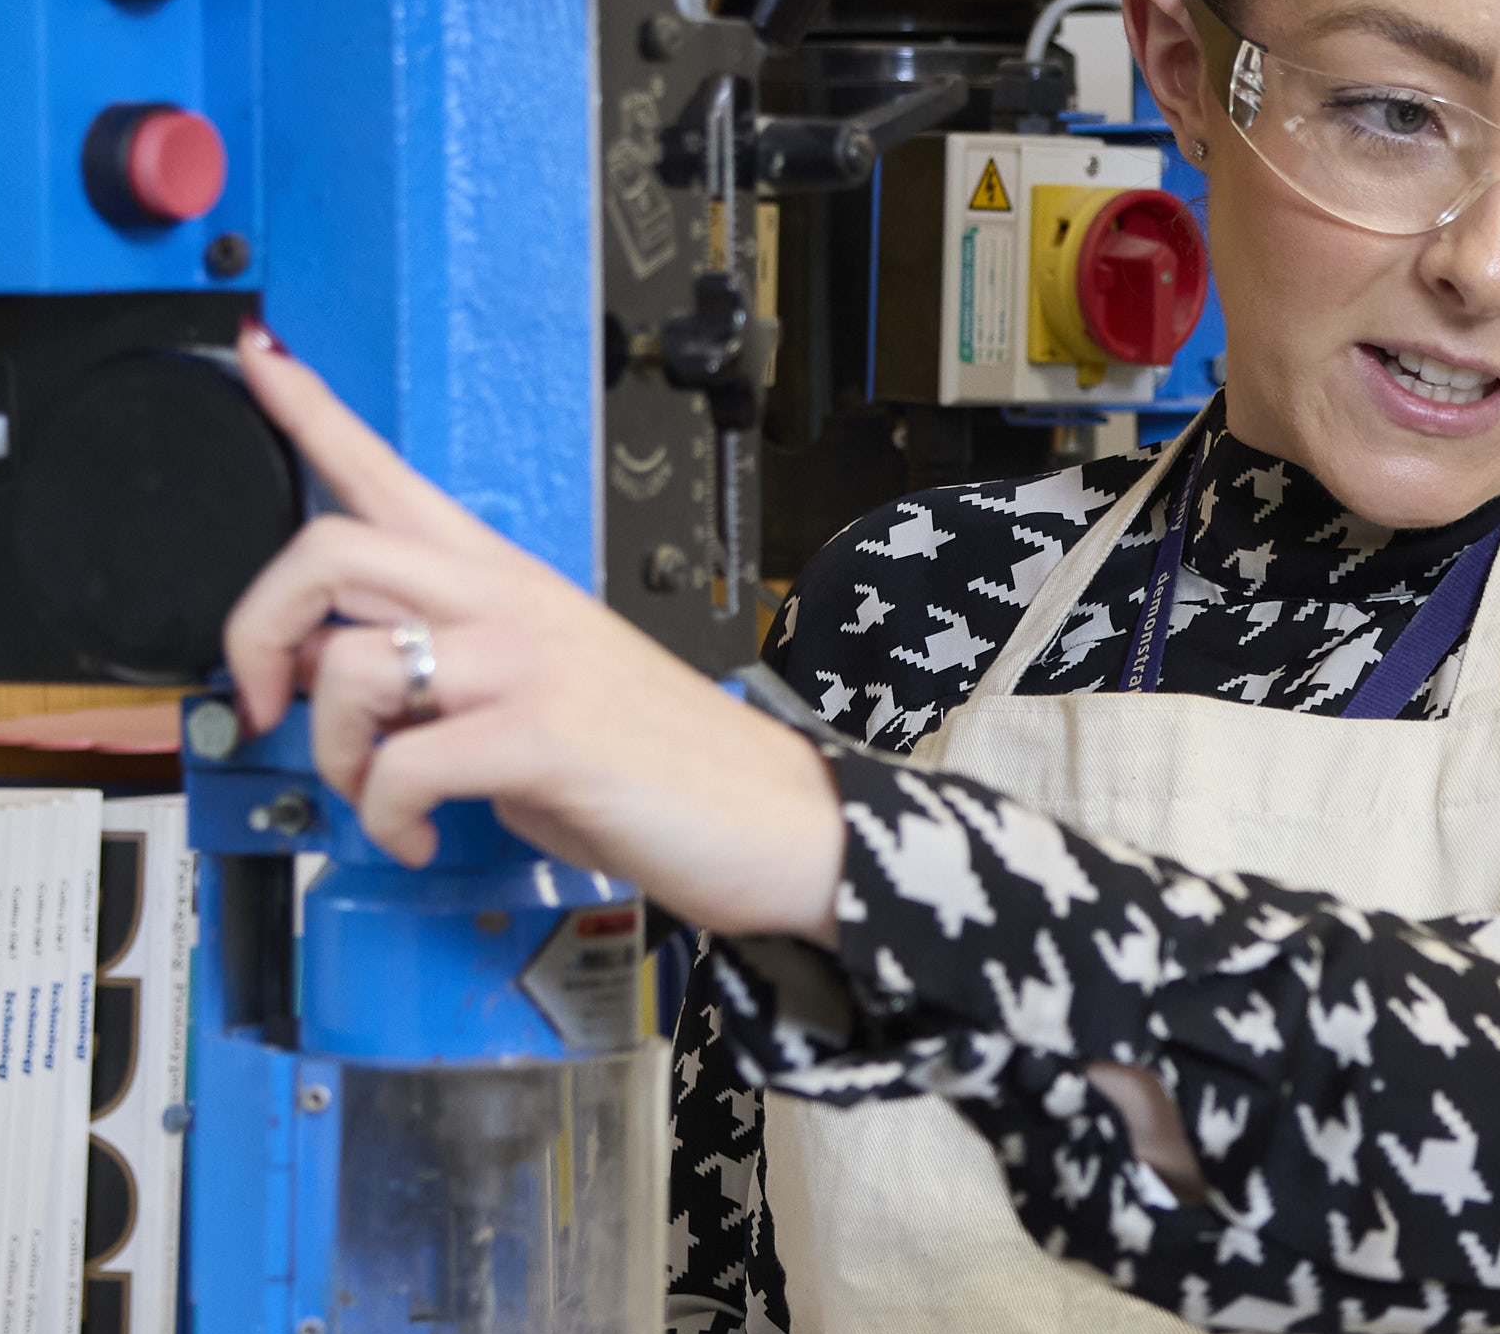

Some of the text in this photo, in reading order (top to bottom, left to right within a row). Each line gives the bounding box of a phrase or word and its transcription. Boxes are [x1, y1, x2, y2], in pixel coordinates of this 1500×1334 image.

[22, 986, 41, 1076] Technology
[44, 981, 64, 1072] Technology
[76, 973, 93, 1061] Technology
